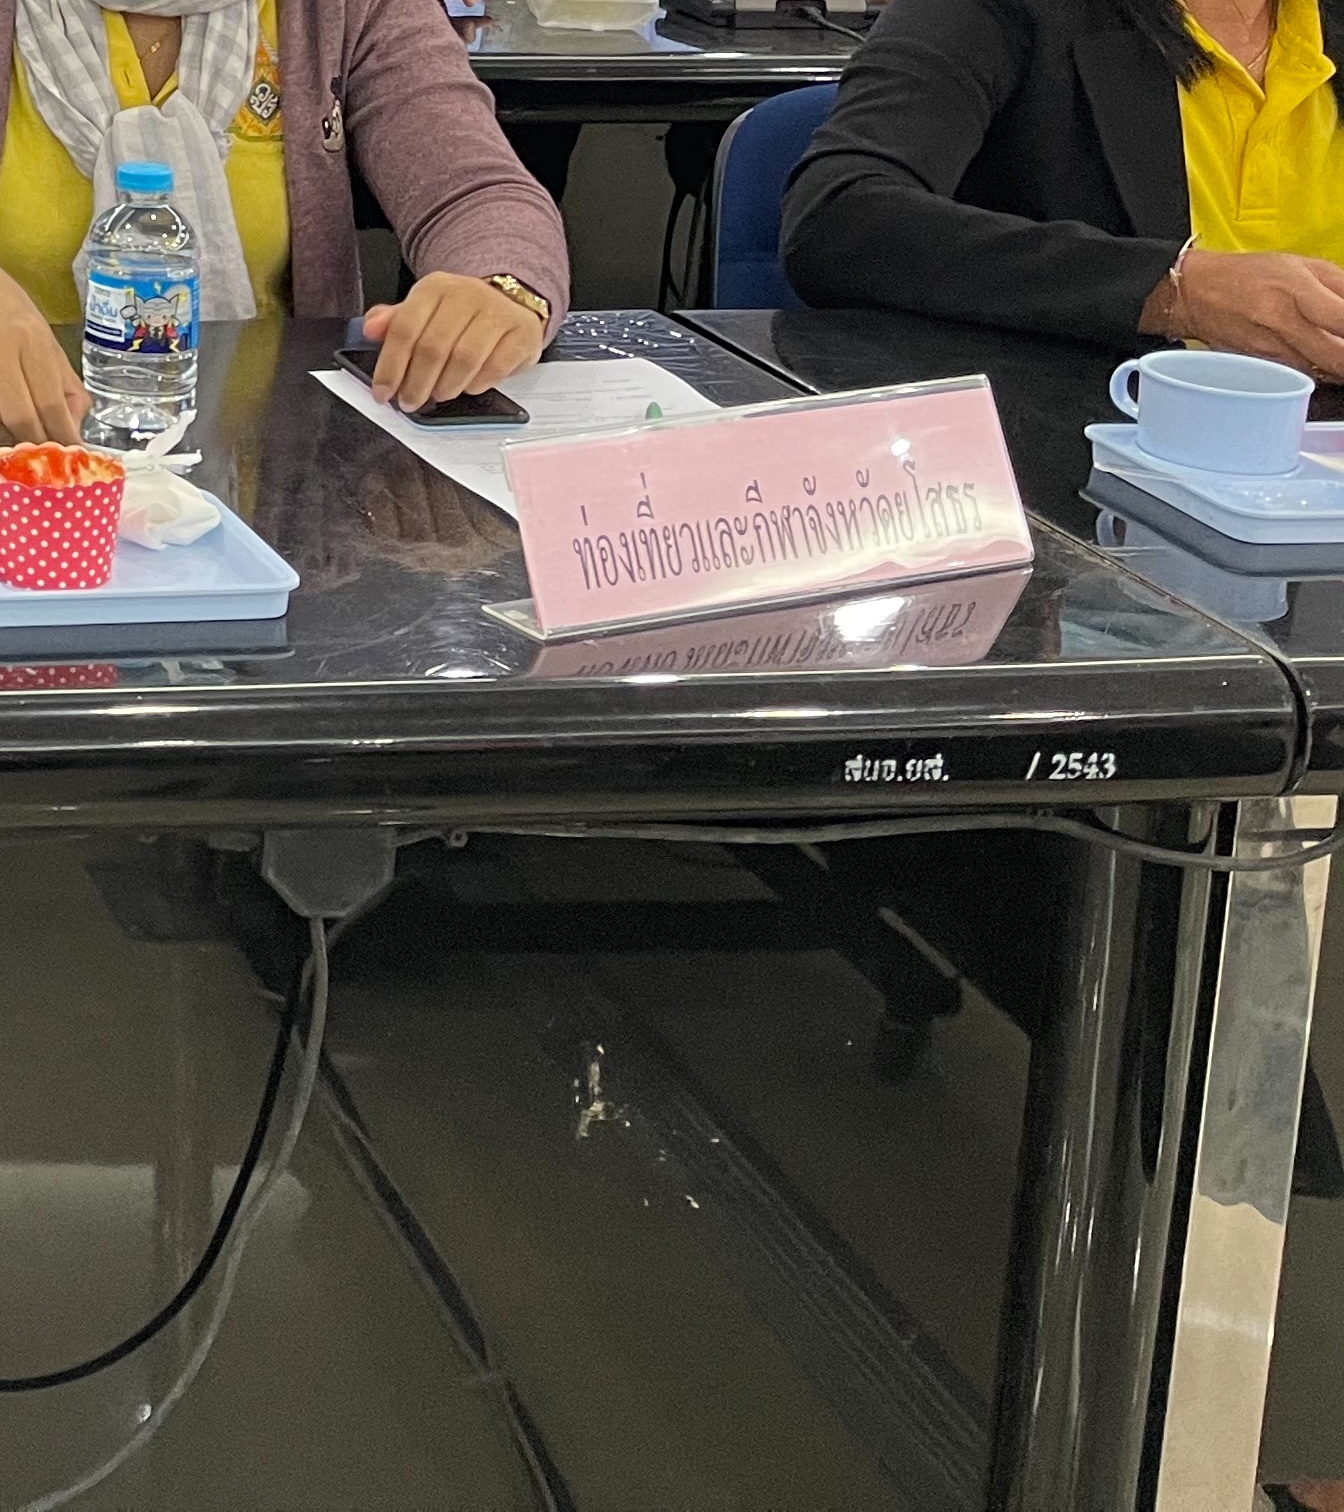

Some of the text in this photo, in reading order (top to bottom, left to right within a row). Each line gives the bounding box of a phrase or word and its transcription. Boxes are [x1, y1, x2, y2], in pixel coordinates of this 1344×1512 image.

[572, 459, 984, 590] ท่องเที่ยวและกีฬาจังหวัดยโสธร
[1049, 752, 1117, 780] 2543
